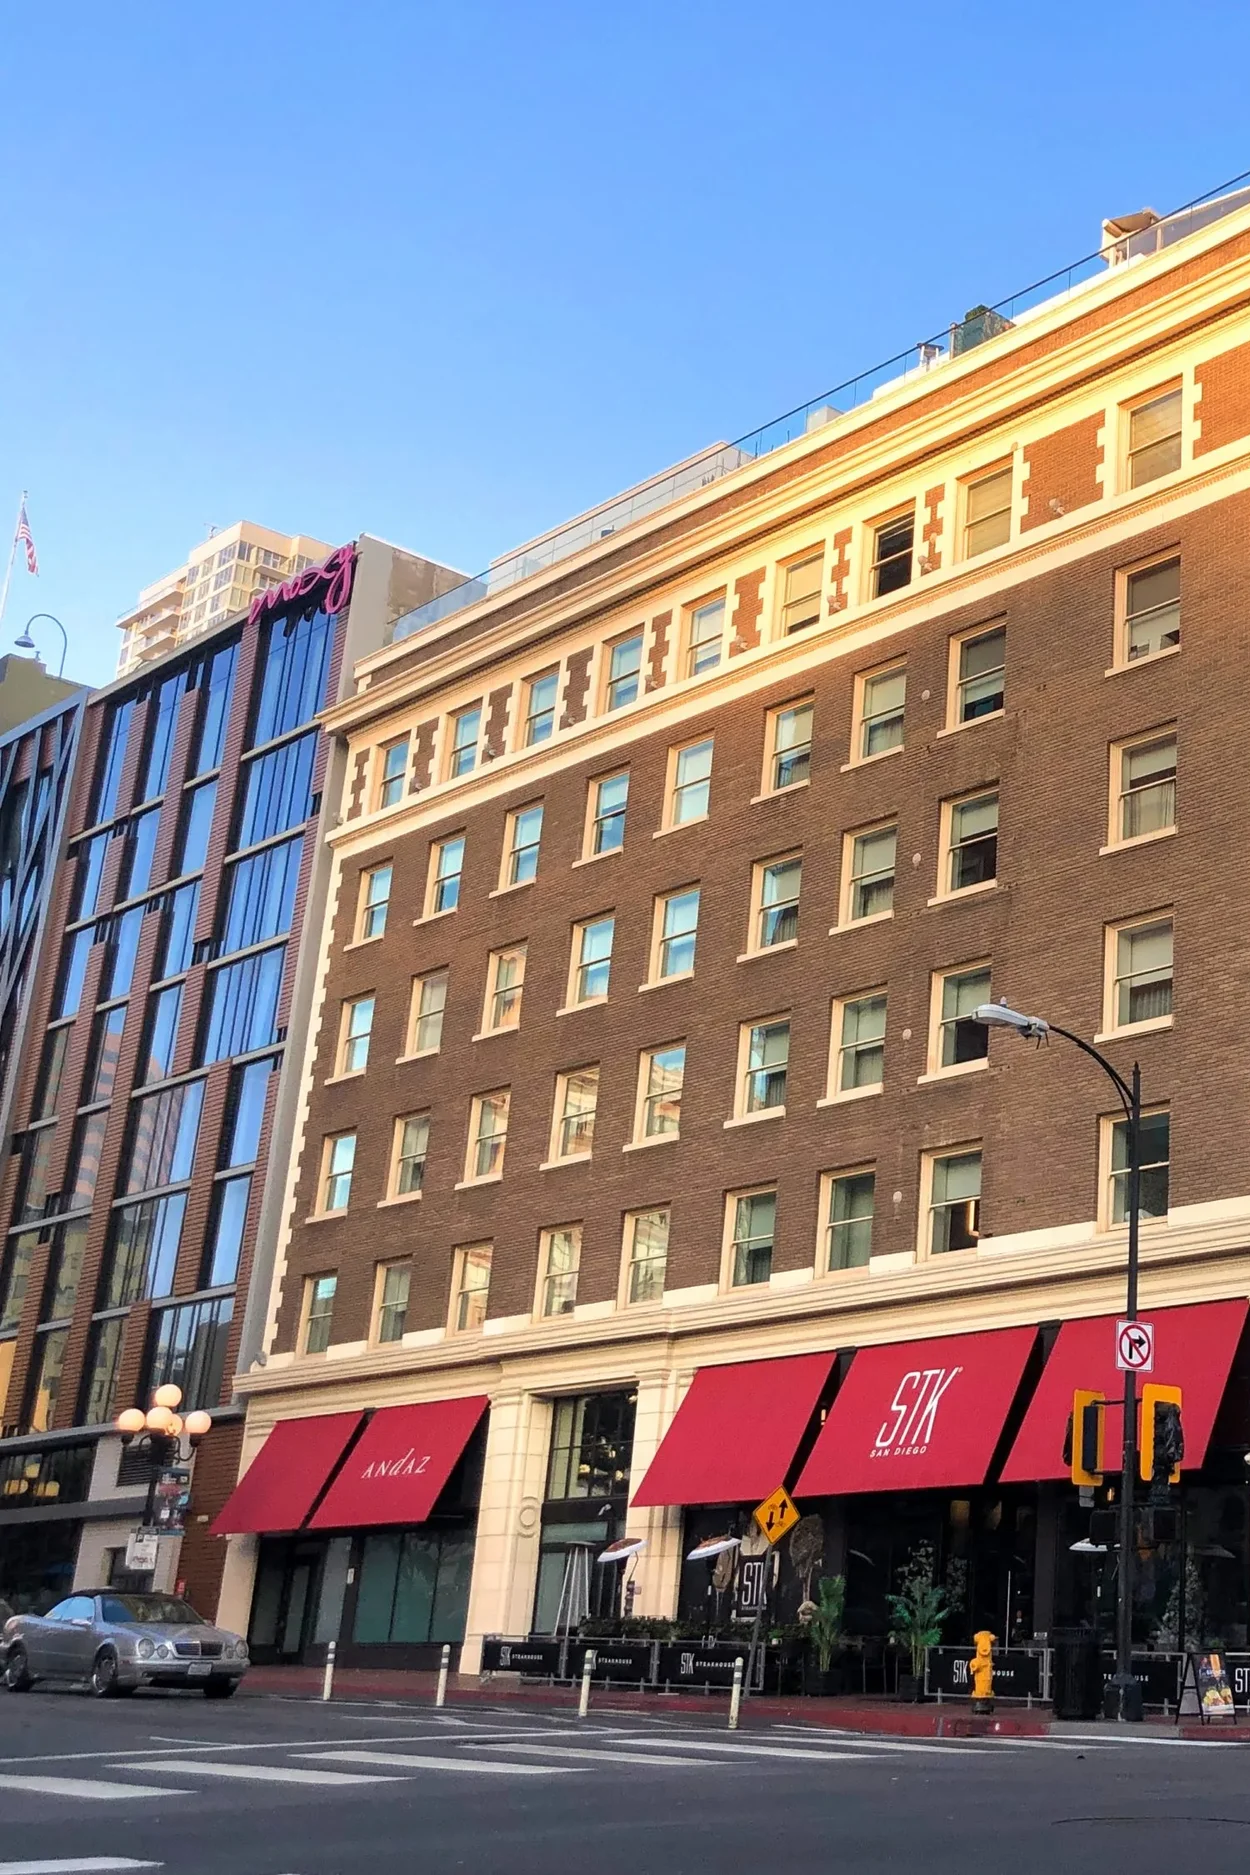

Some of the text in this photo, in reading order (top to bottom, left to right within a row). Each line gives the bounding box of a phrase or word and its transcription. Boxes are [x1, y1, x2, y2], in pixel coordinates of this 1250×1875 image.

[875, 1366, 960, 1448] STK
[869, 1446, 927, 1458] SAN DIEGO
[680, 1652, 735, 1674] STK STEAKHOUSE
[953, 1660, 968, 1683] STK
